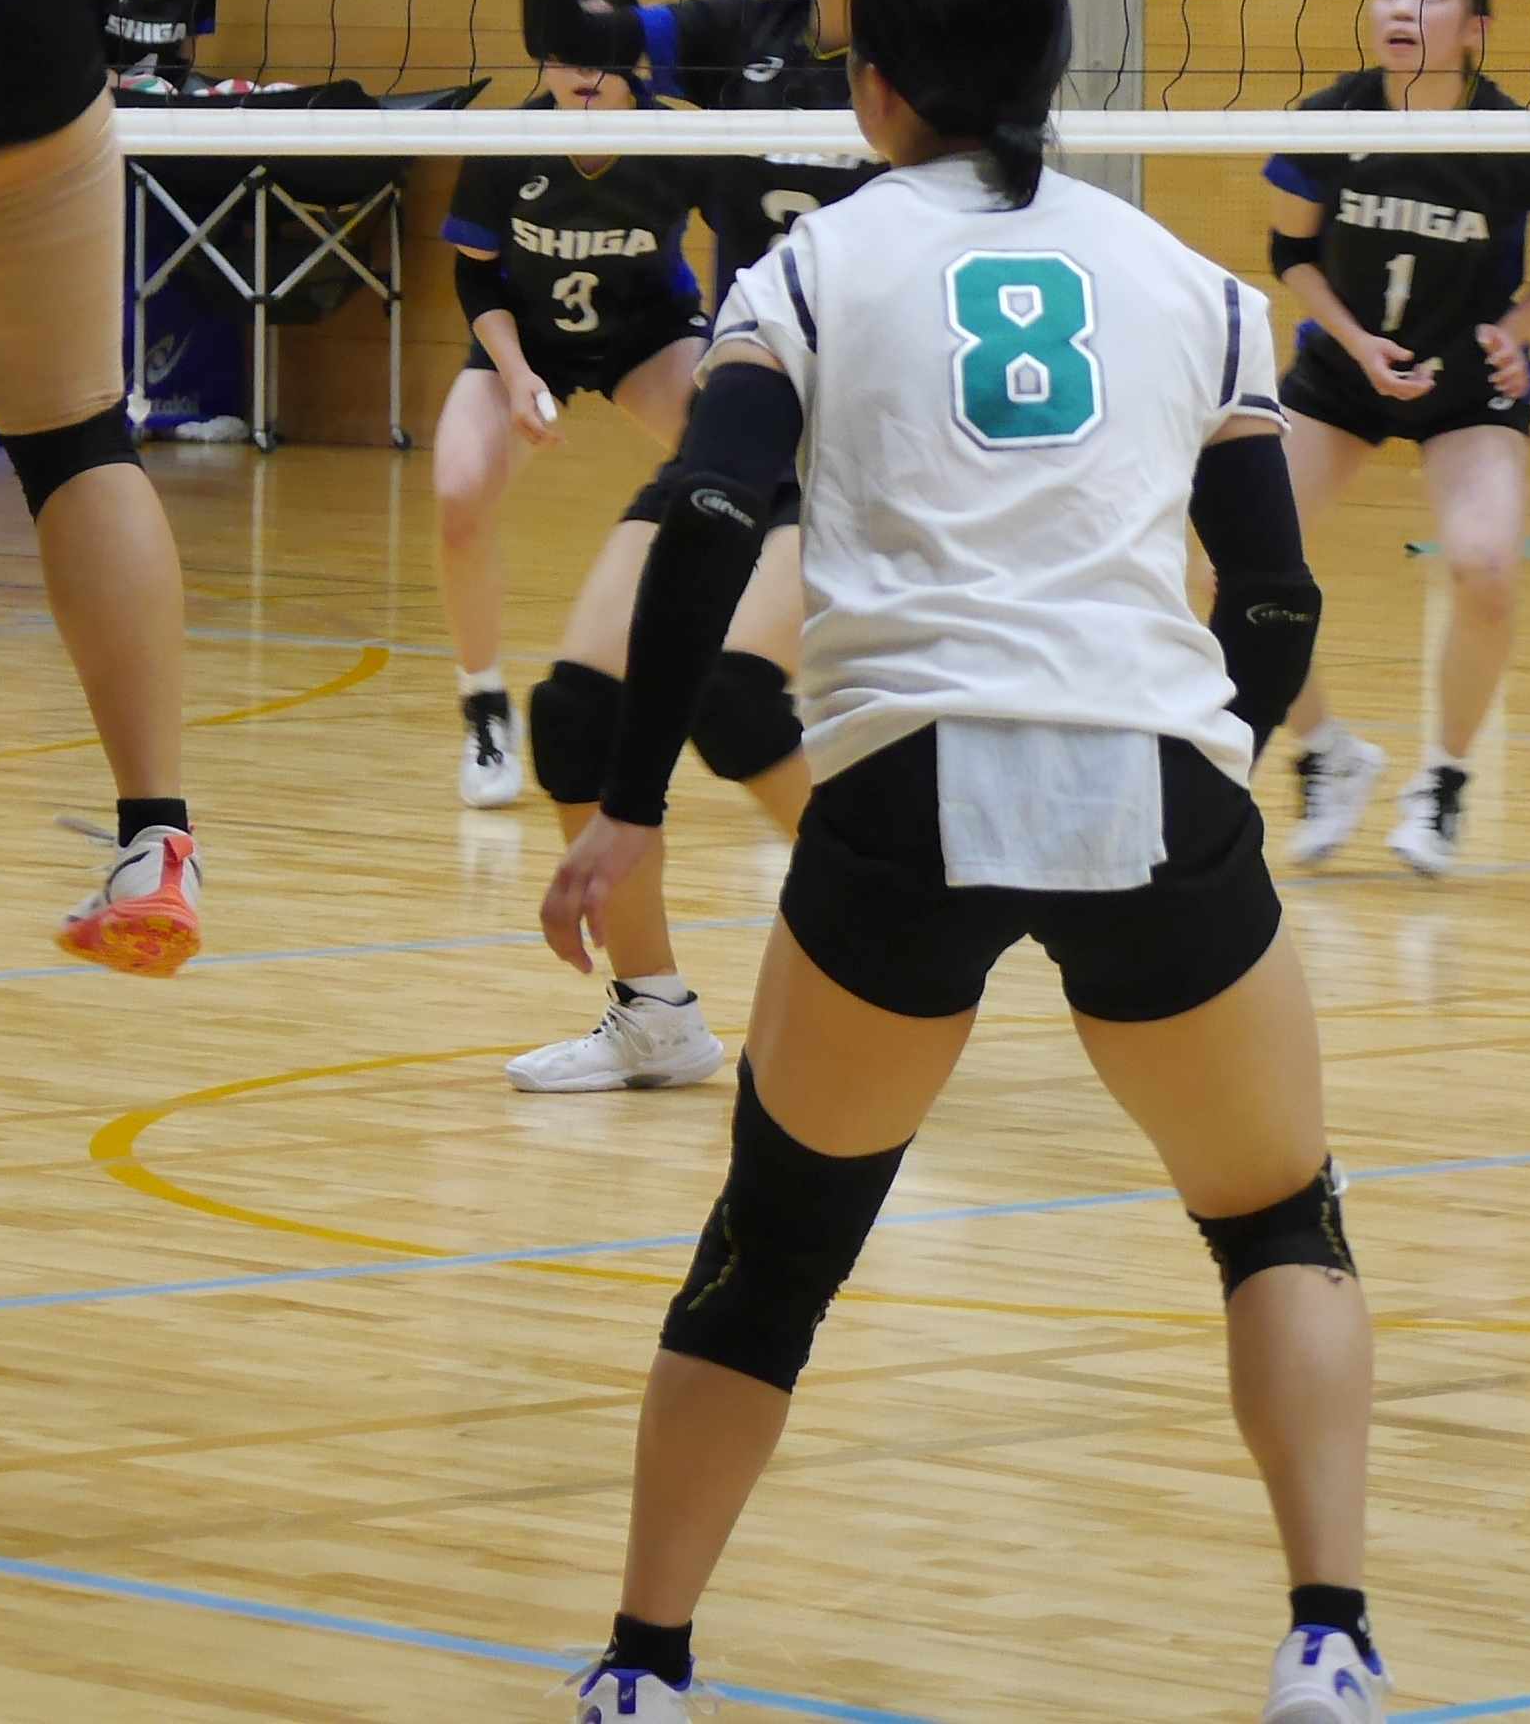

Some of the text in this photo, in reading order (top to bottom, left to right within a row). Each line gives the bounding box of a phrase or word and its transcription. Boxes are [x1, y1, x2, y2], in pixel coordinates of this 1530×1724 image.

[105, 14, 187, 44] SHIGA
[511, 217, 658, 260] SHIGA
[1335, 188, 1490, 243] SHIGA
[552, 271, 599, 333] 3
[1381, 253, 1417, 332] 1
[944, 249, 1104, 450] 8
